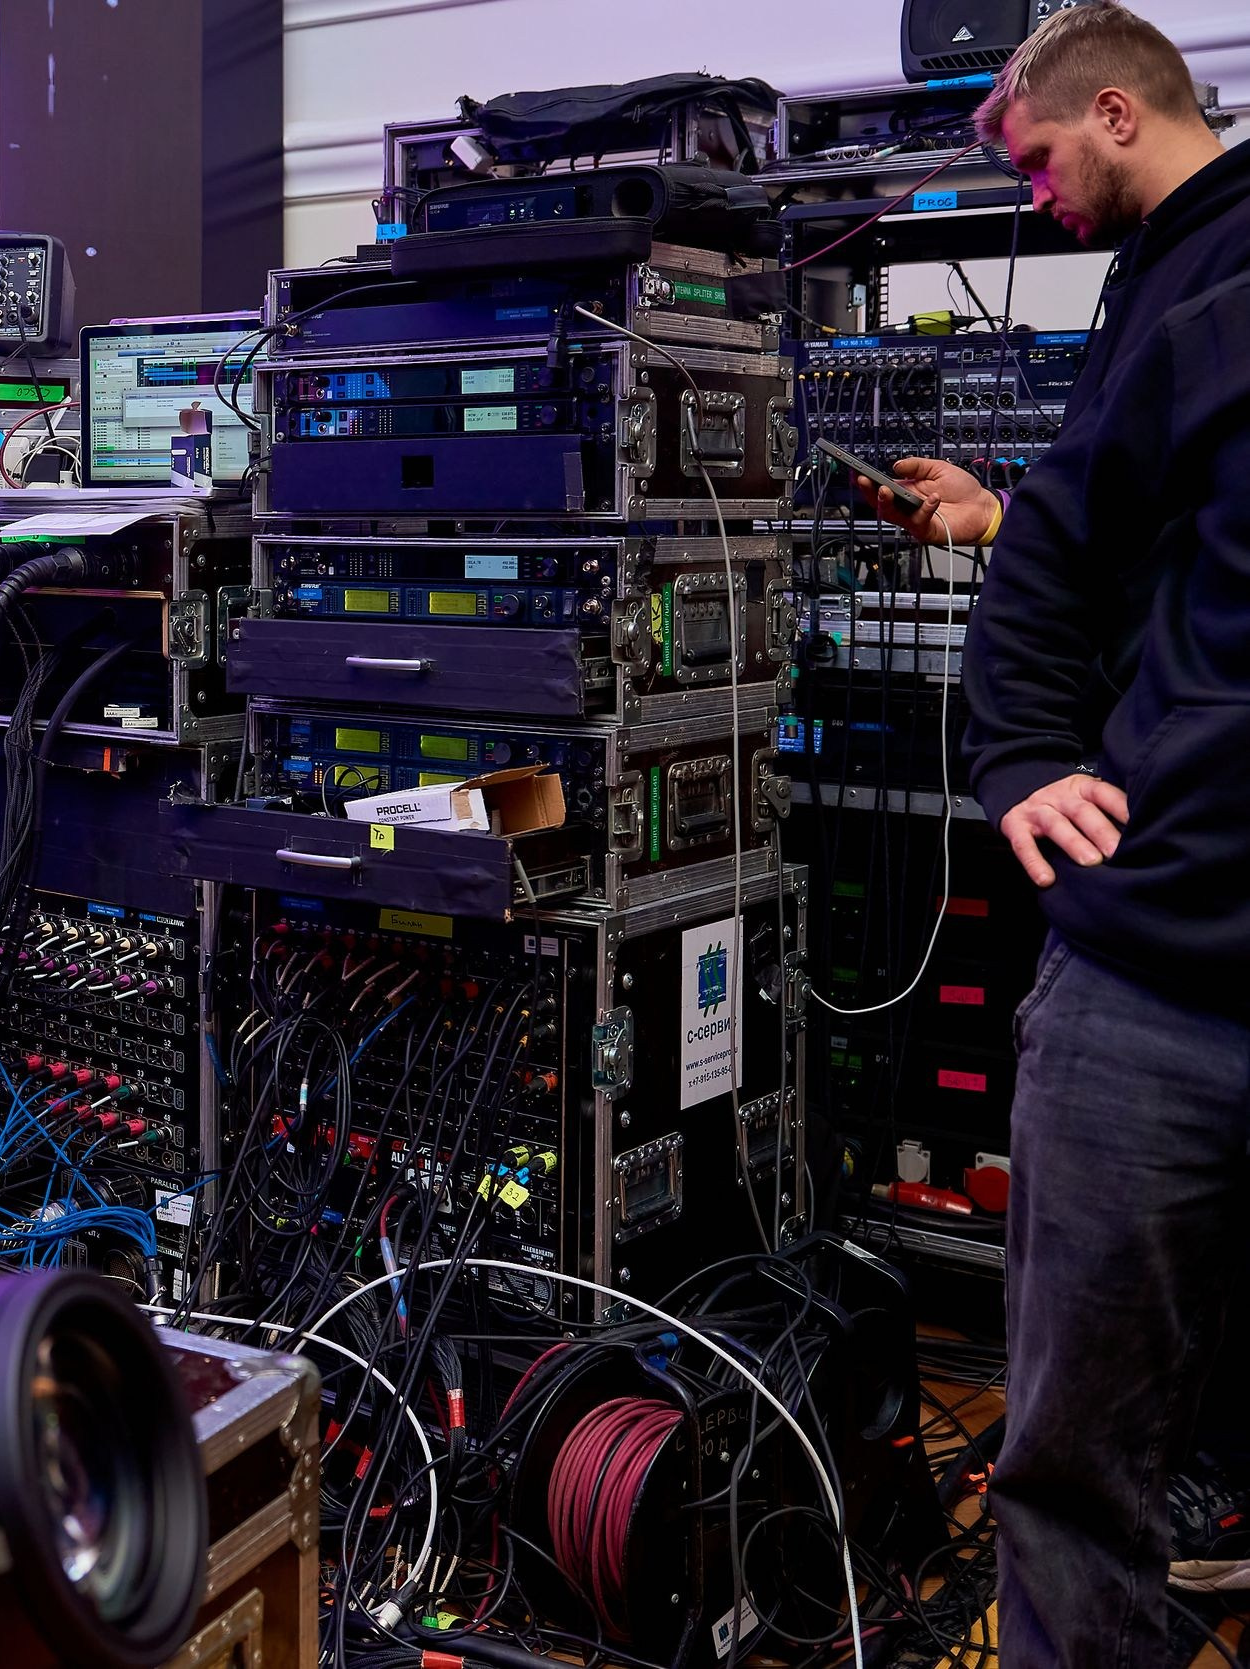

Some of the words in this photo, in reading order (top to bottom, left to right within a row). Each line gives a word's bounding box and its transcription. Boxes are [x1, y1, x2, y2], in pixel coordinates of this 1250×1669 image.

[918, 197, 953, 207] PROG
[714, 291, 726, 300] SHUR
[17, 387, 51, 398] CSCO
[376, 802, 422, 816] PROCELL
[687, 1016, 737, 1044] с-серви
[686, 1046, 738, 1071] www.s-serviceprou
[150, 1176, 180, 1192] PARALLEL
[506, 1187, 519, 1202] 32
